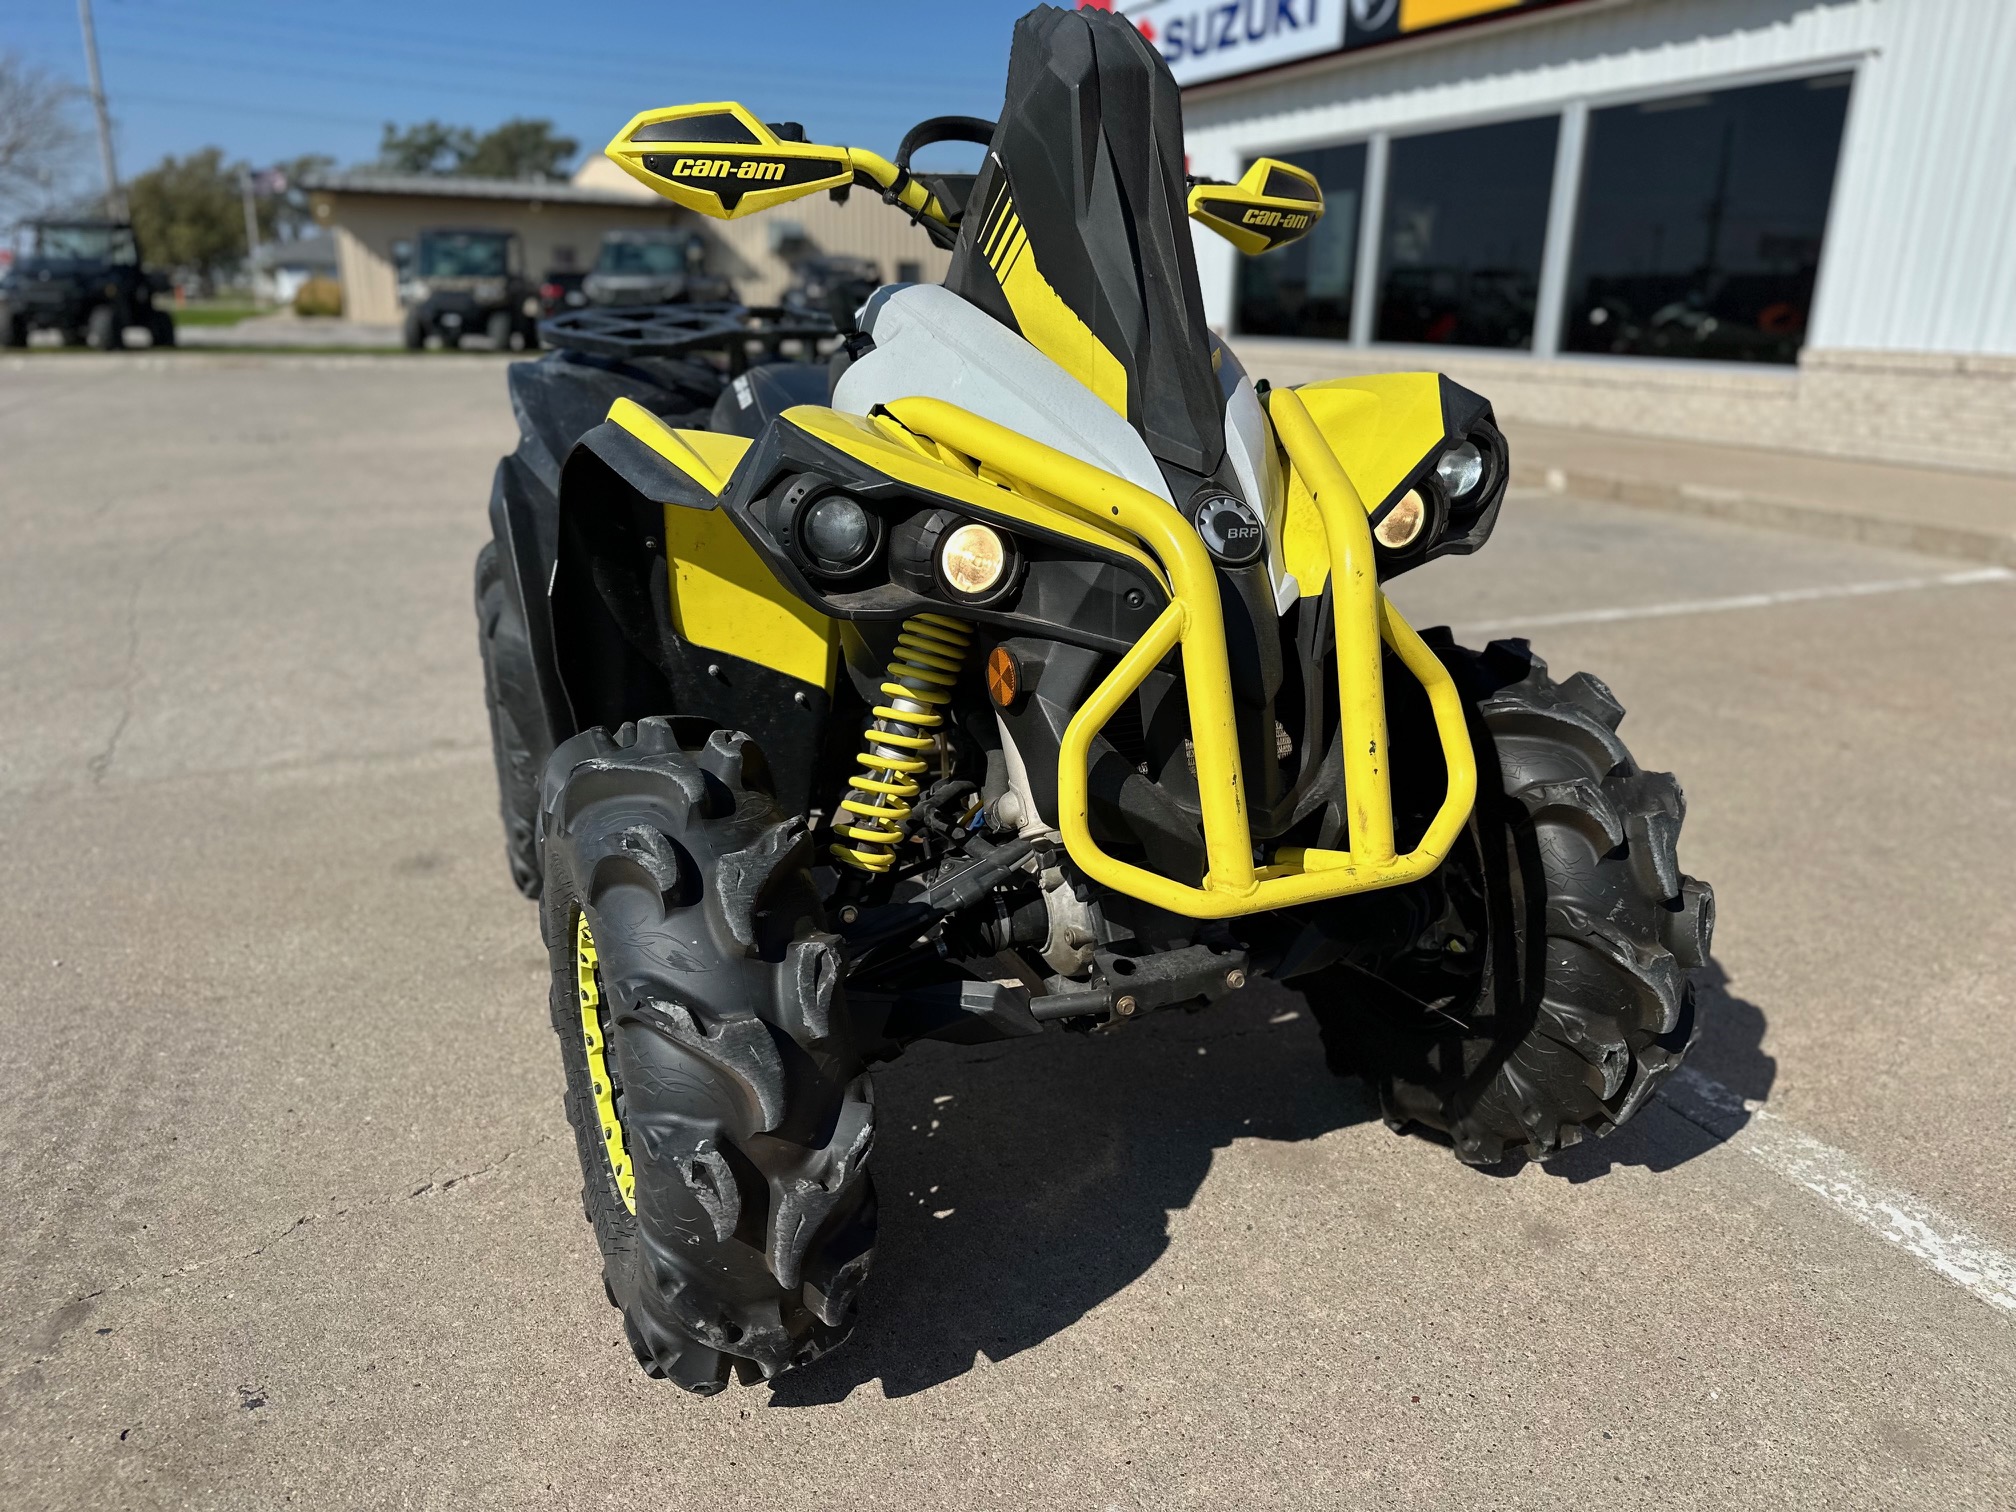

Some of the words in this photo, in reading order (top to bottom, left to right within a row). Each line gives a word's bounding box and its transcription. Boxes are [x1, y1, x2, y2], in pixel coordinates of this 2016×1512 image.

[1162, 0, 1319, 63] SUZUKI
[671, 158, 786, 181] can-am
[1242, 208, 1309, 230] can-am
[1227, 527, 1259, 539] BRP
